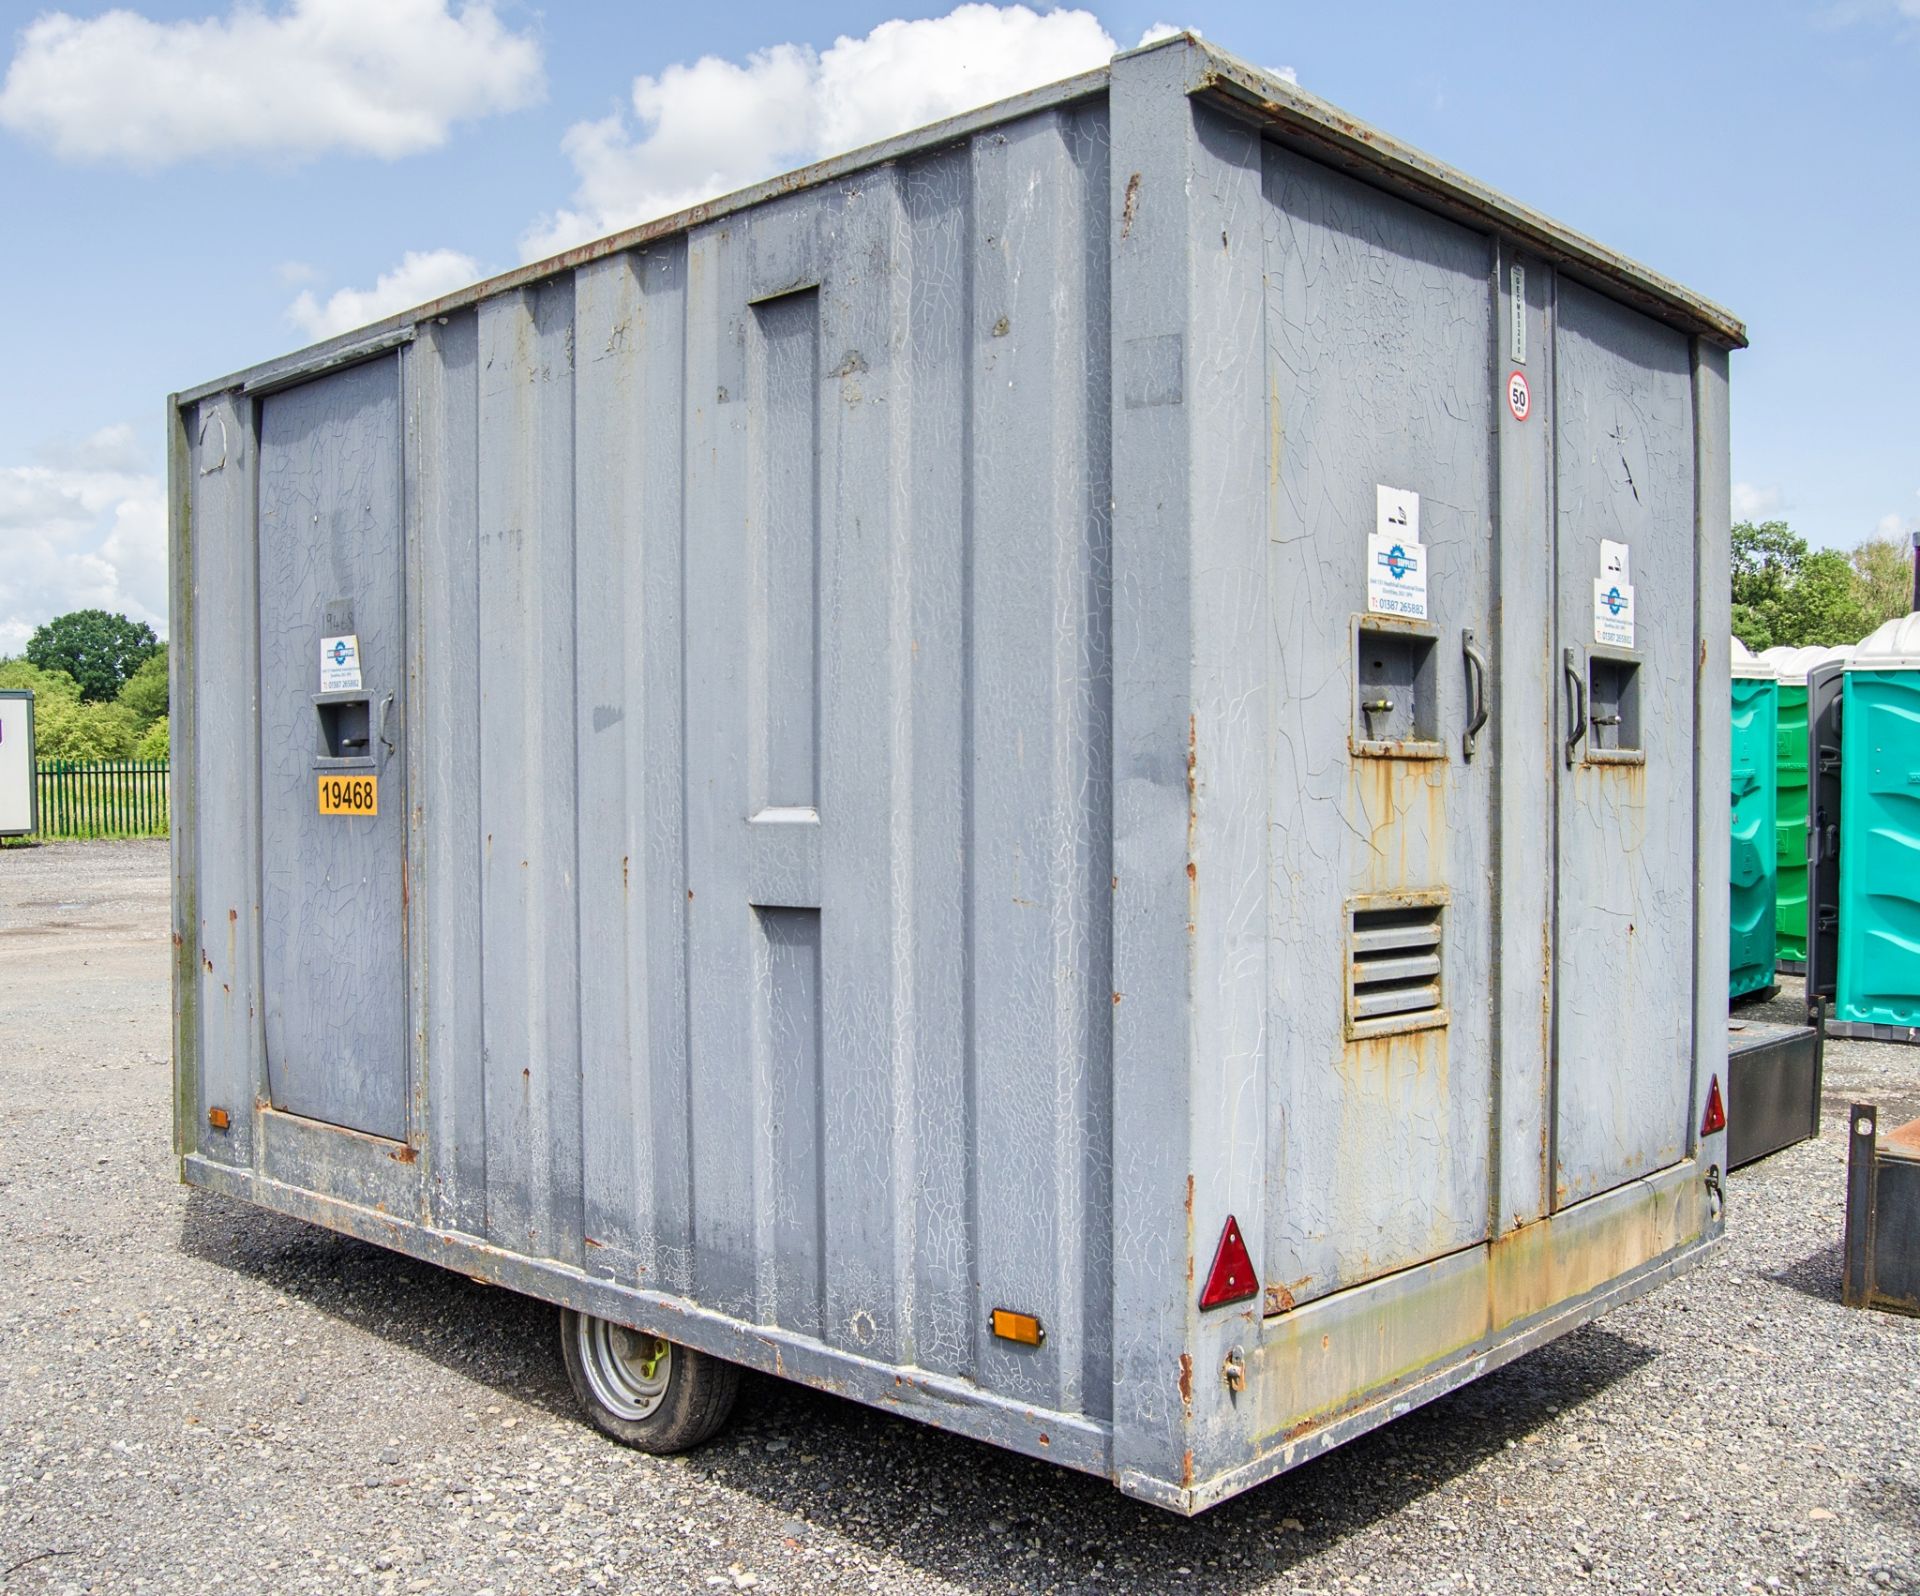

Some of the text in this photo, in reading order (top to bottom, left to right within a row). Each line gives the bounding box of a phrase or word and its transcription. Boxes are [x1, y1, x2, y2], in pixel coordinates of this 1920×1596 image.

[1513, 388, 1526, 407] 50
[1371, 597, 1424, 614] T: 01387 265882
[322, 781, 373, 809] 19468
